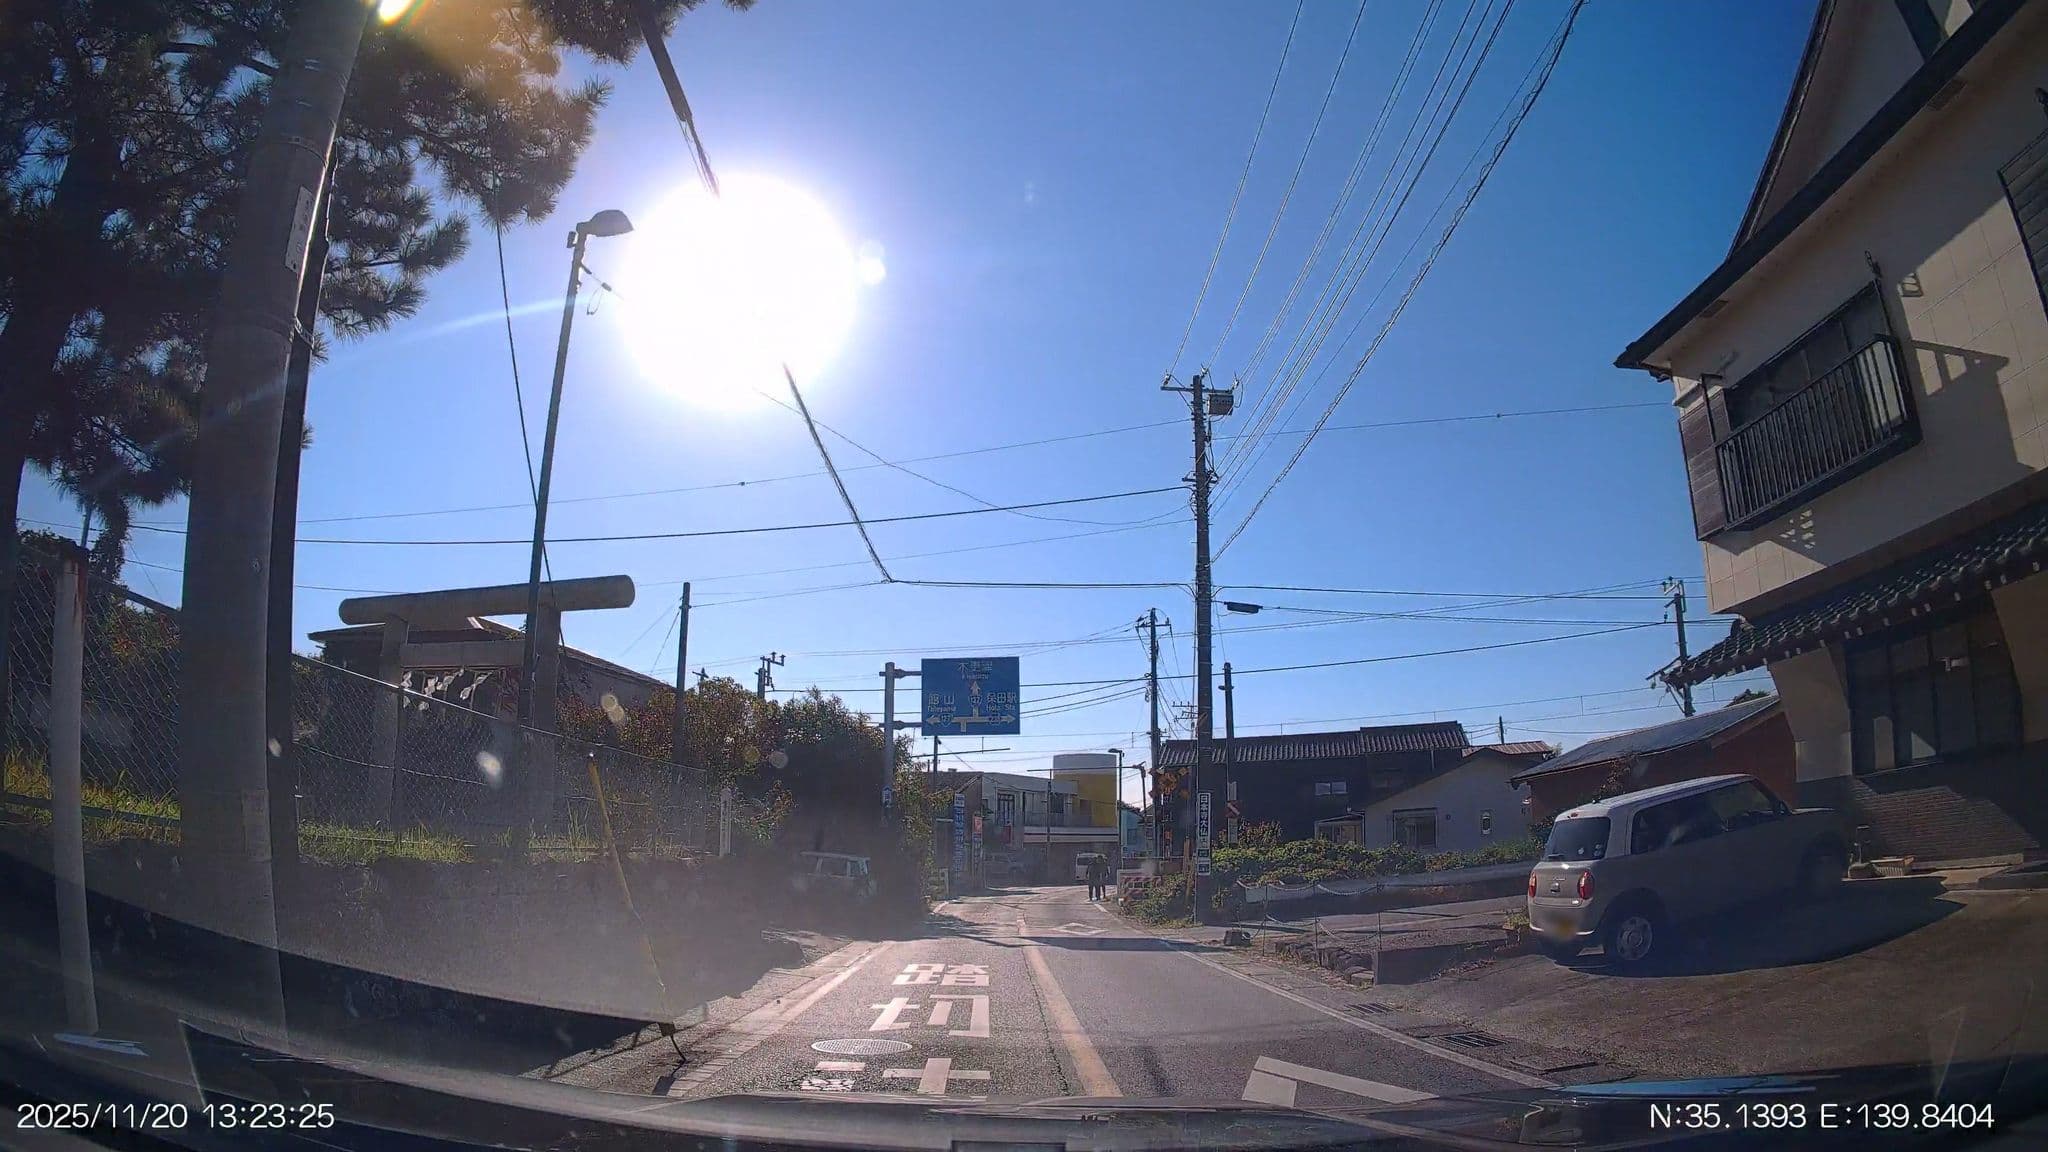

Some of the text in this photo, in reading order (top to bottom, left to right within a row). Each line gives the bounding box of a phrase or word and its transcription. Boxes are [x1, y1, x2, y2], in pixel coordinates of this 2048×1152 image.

[1200, 796, 1208, 836] 日本寺大仏
